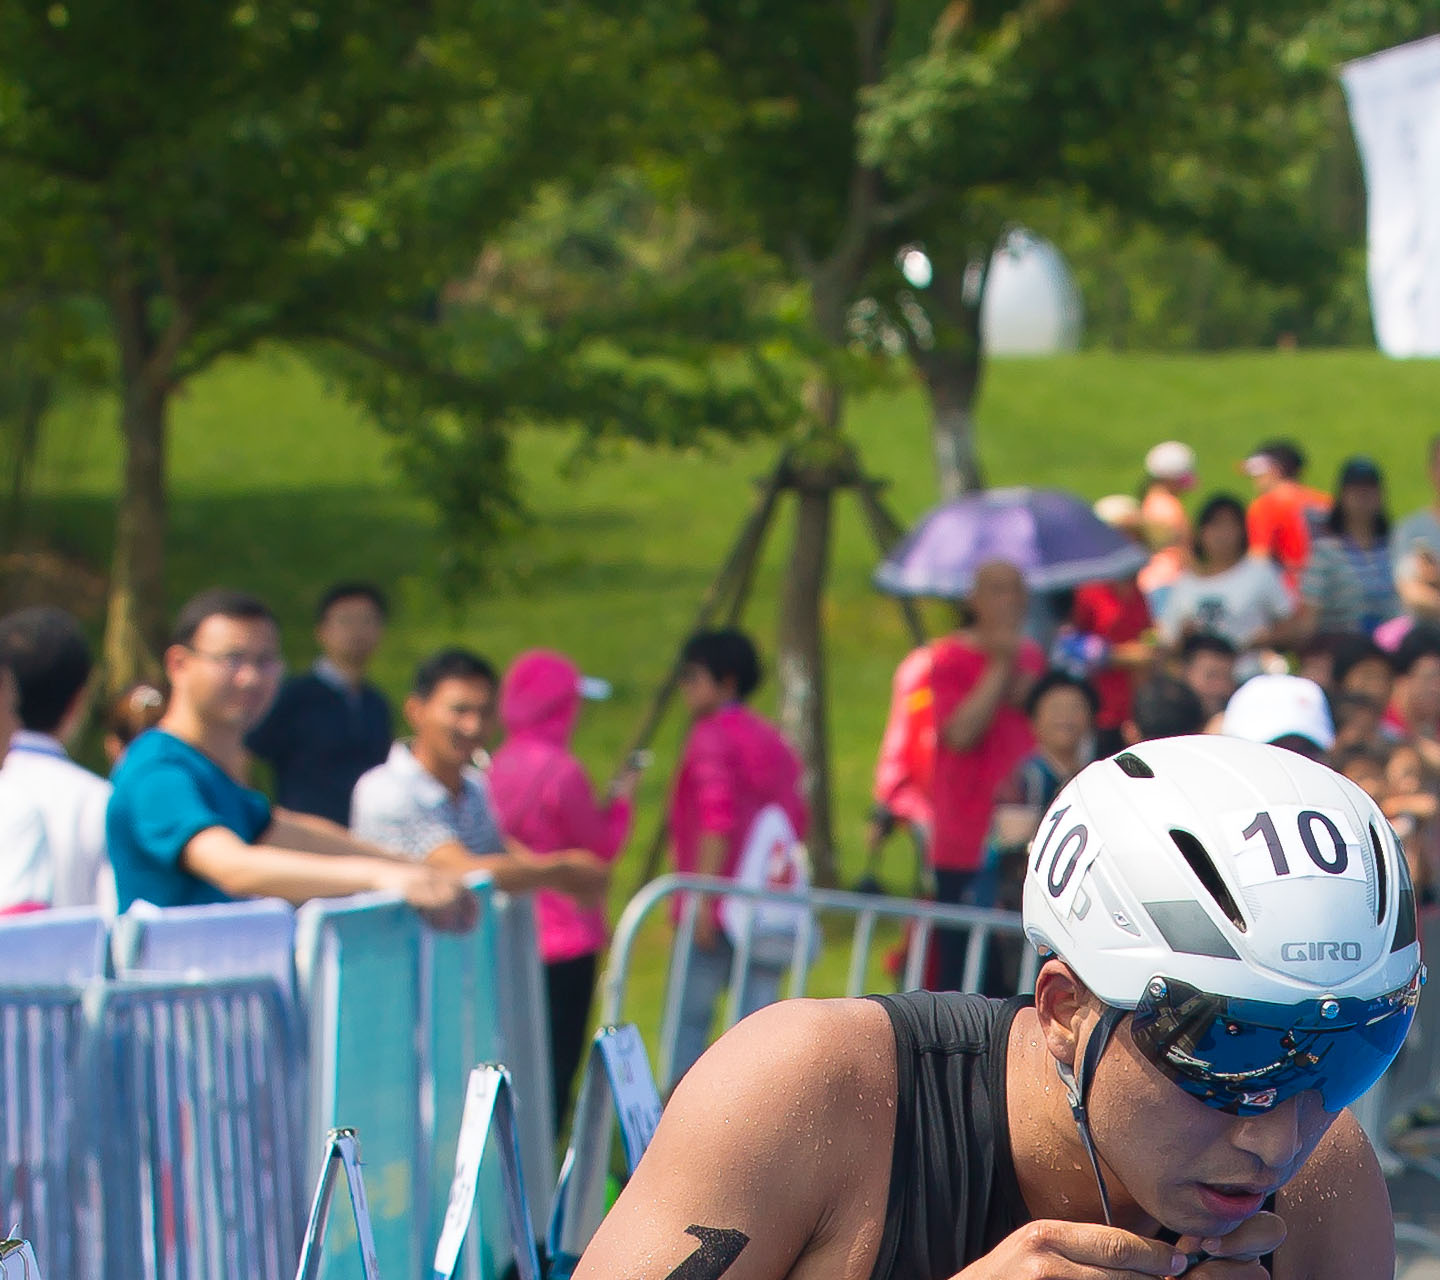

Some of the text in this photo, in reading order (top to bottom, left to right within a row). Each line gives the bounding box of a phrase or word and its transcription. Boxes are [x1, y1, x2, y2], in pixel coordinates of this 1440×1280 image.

[1034, 803, 1089, 898] 10
[1242, 809, 1349, 877] 10
[1281, 941, 1363, 962] GIRO
